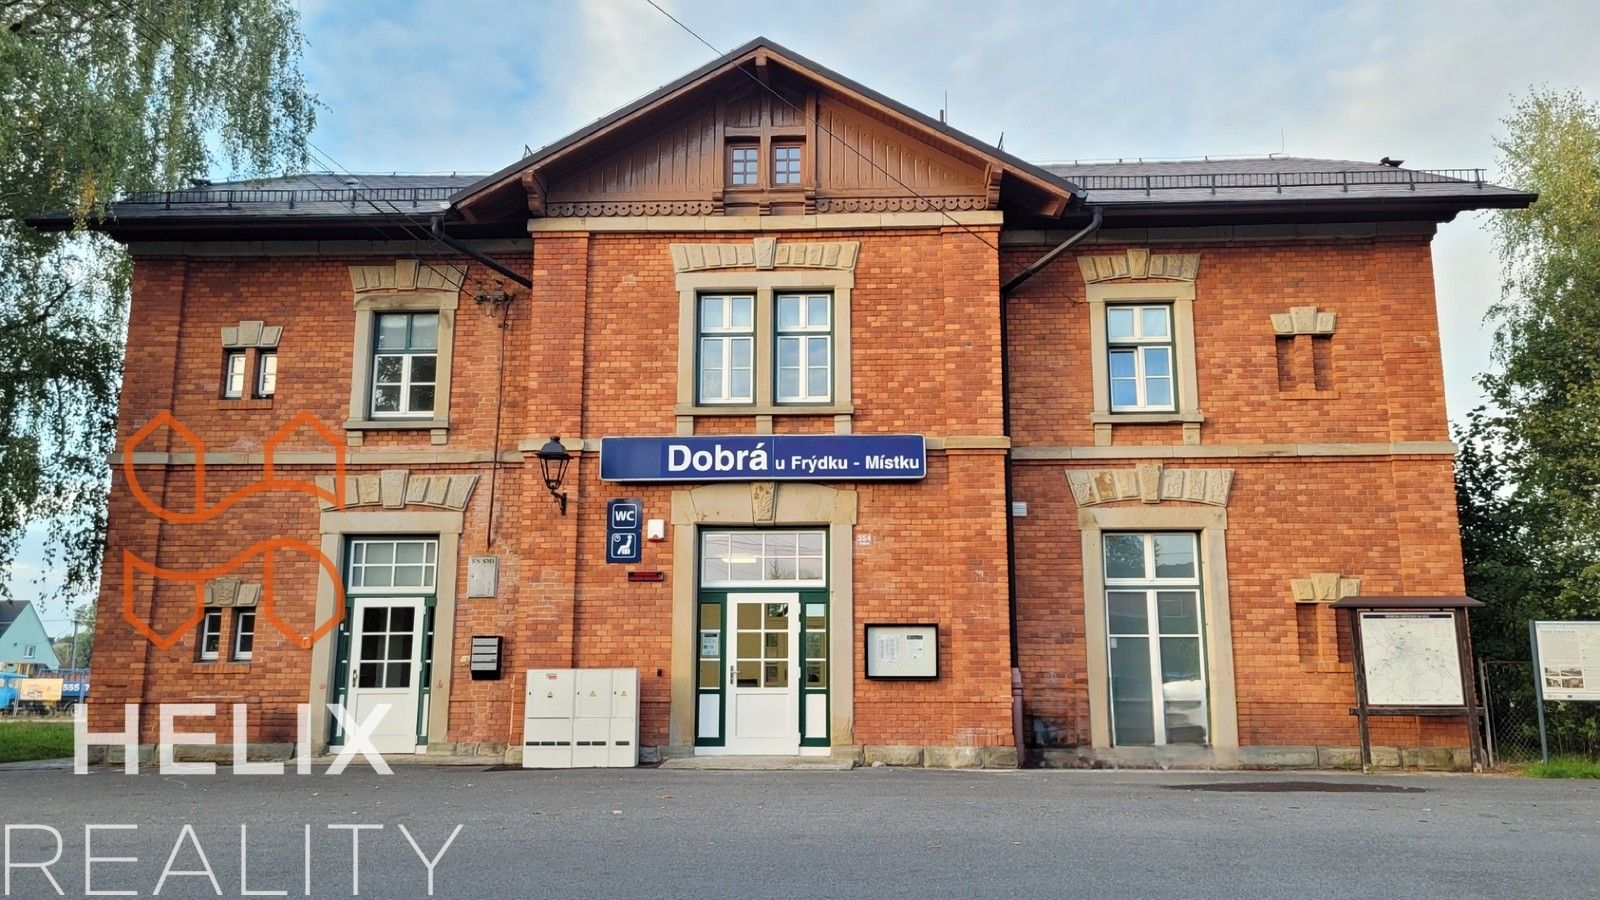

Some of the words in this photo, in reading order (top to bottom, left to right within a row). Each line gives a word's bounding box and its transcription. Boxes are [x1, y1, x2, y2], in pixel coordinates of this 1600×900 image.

[667, 442, 768, 472] Dobrá
[775, 459, 785, 470] u
[791, 455, 848, 474] Frýdku
[865, 455, 920, 470] Místku
[615, 510, 635, 521] WC
